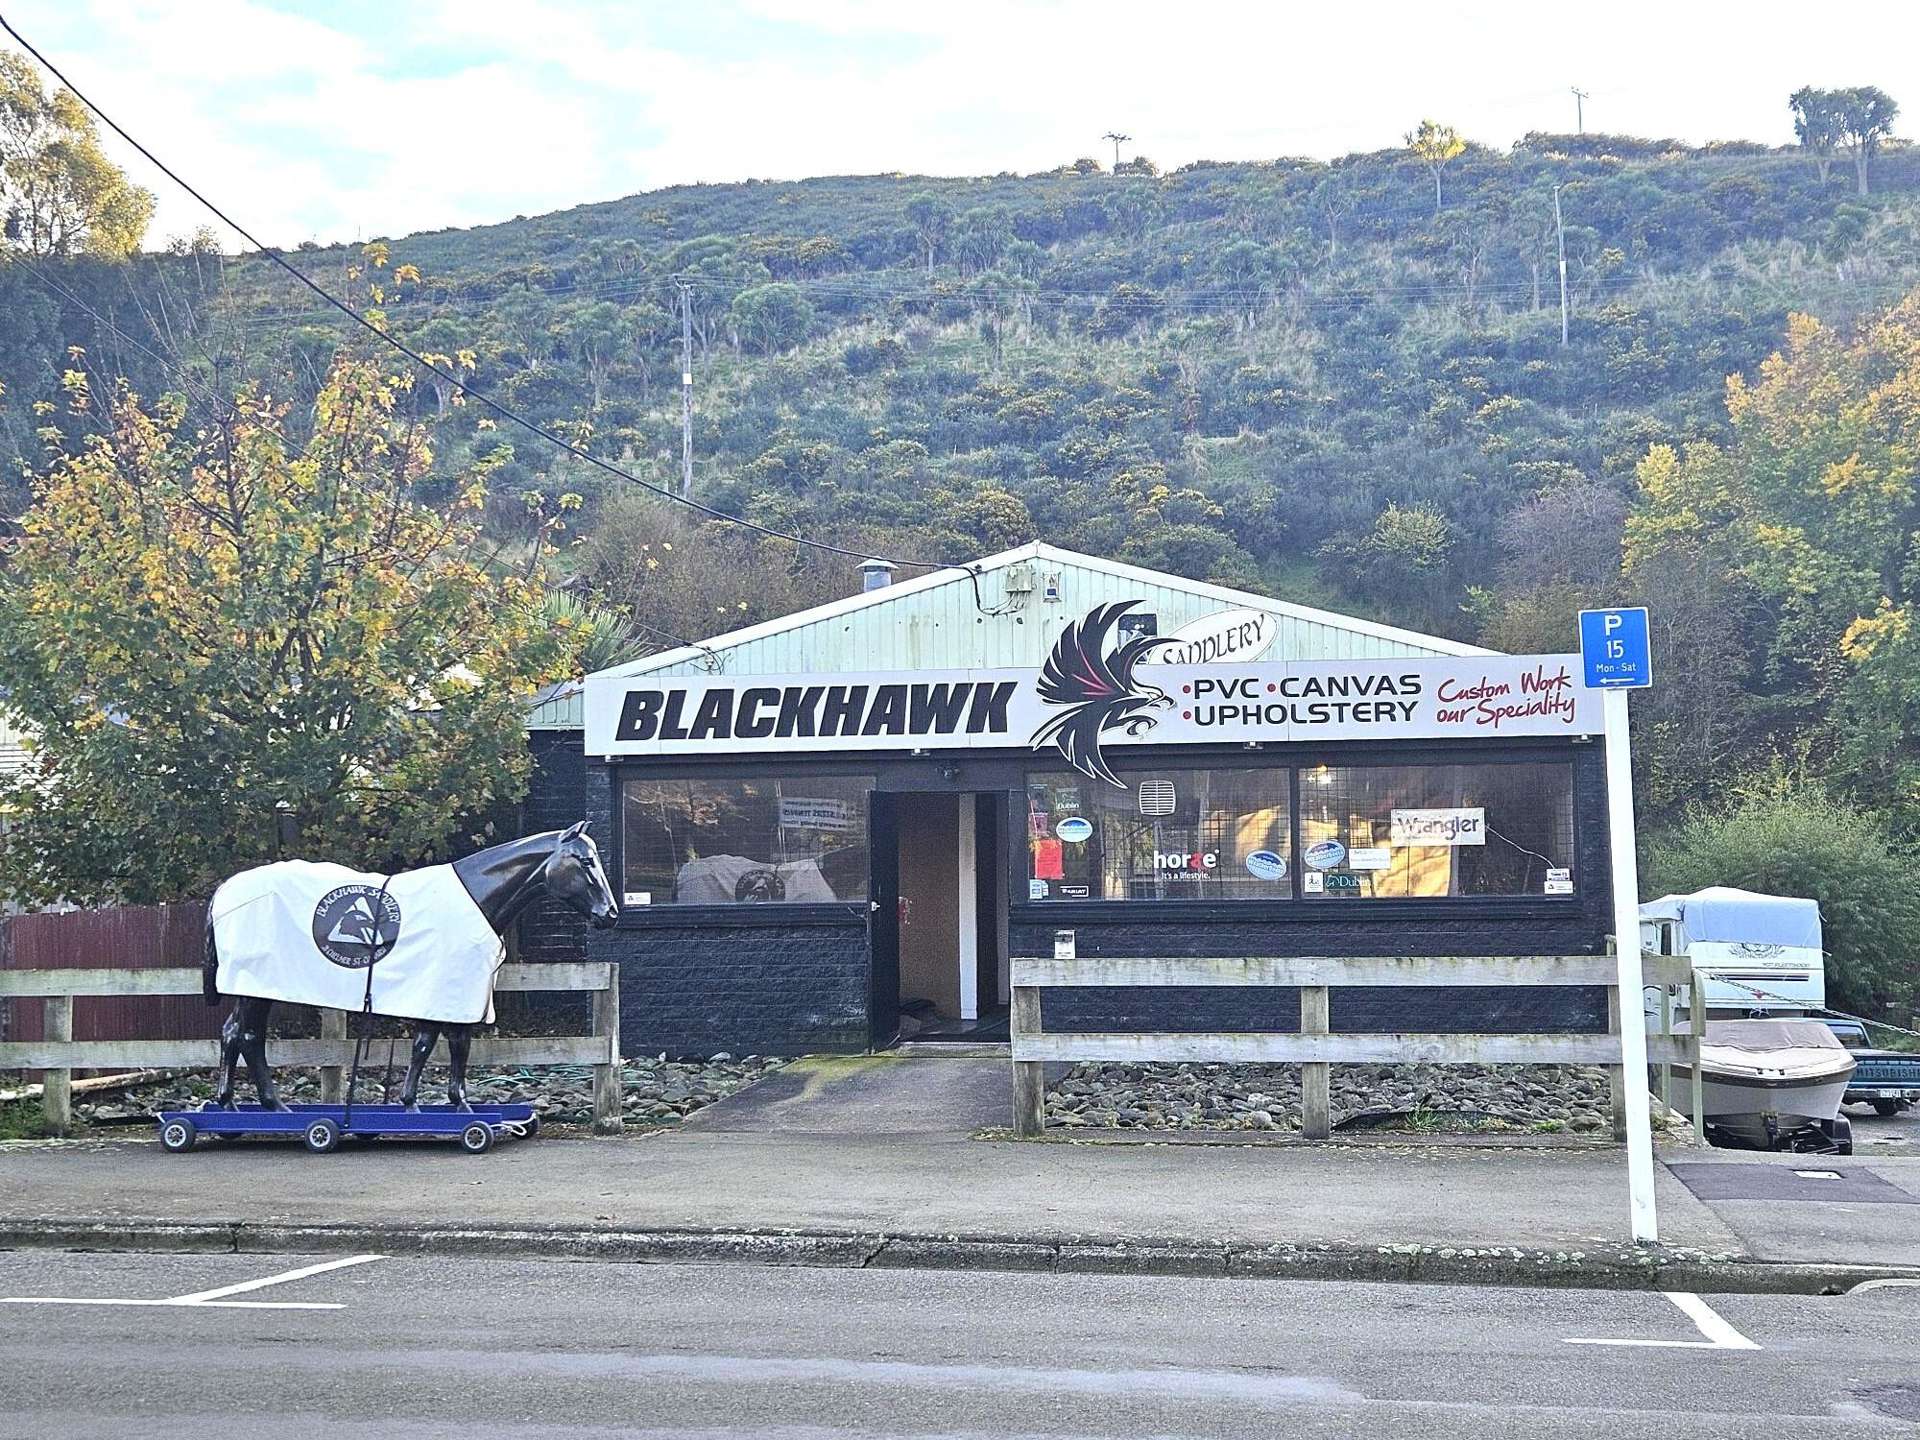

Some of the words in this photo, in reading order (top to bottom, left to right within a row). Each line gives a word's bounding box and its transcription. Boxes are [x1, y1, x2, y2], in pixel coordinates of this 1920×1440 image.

[1162, 613, 1265, 665] SADDLERY
[1604, 614, 1623, 637] P
[1606, 640, 1625, 659] 15
[1194, 678, 1260, 700] PVC
[1279, 674, 1422, 699] CANVAS
[1437, 676, 1510, 703] Custom
[1520, 664, 1573, 694] Work
[615, 681, 1019, 741] BLACKHAWK
[1194, 701, 1419, 727] UPHOLSTERY
[1436, 706, 1476, 723] our
[1475, 690, 1576, 729] Speciality
[1397, 815, 1480, 841] Wrangler
[316, 885, 367, 917] BLACKHAWK
